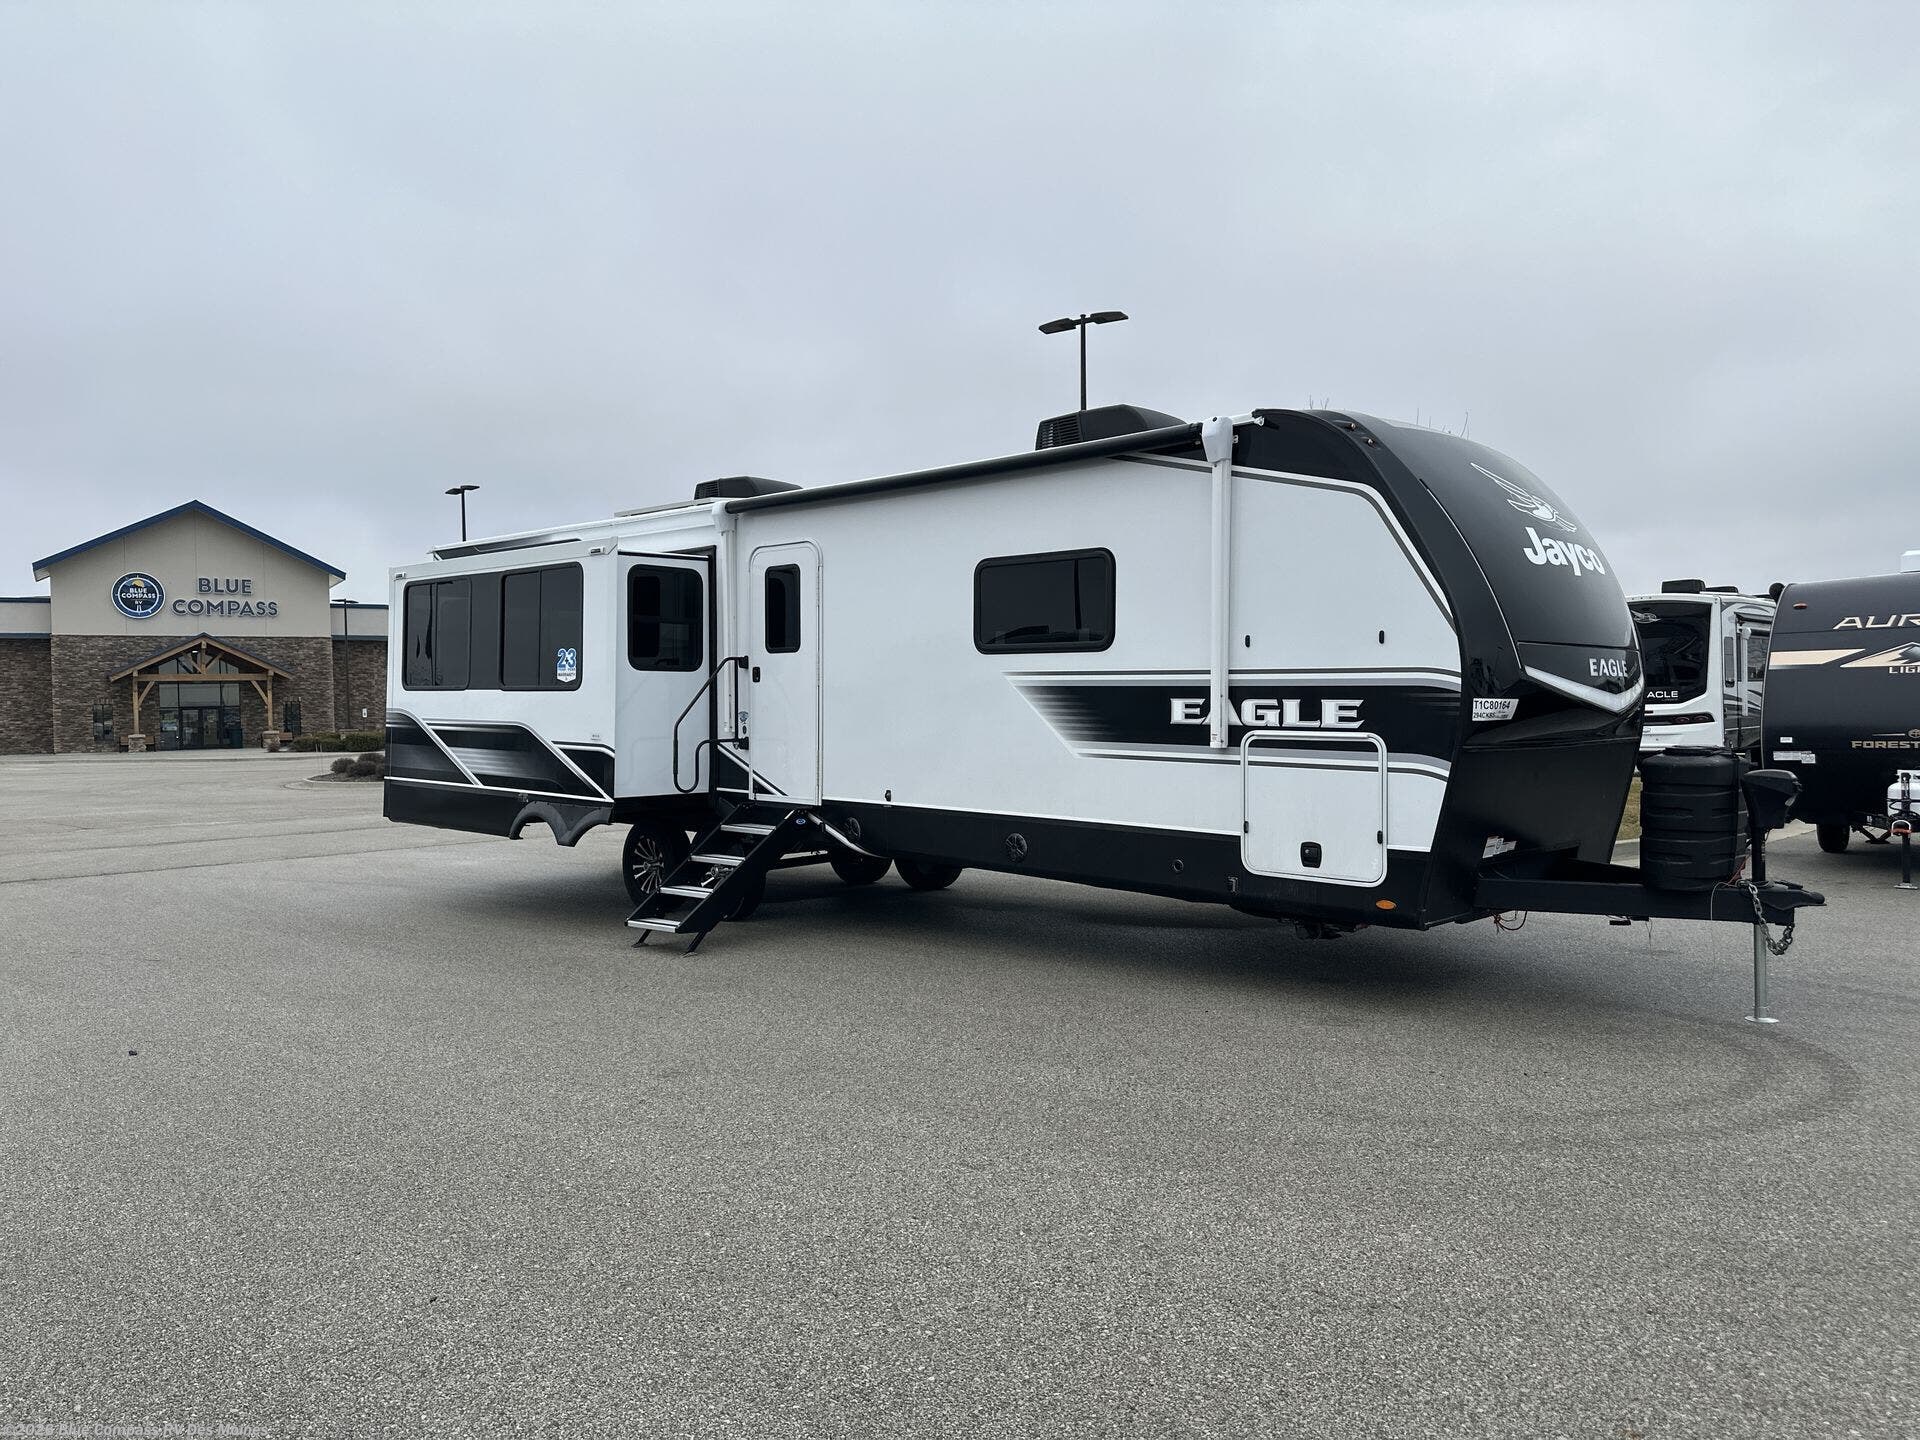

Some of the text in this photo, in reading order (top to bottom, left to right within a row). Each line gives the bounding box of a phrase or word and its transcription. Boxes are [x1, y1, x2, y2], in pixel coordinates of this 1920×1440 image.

[1523, 526, 1606, 577] Jayco
[198, 577, 252, 594] BLUE
[172, 599, 279, 617] COMPASS
[1589, 658, 1628, 678] EAGLE
[1473, 700, 1511, 710] T1C80164
[1852, 740, 1920, 749] FOREST
